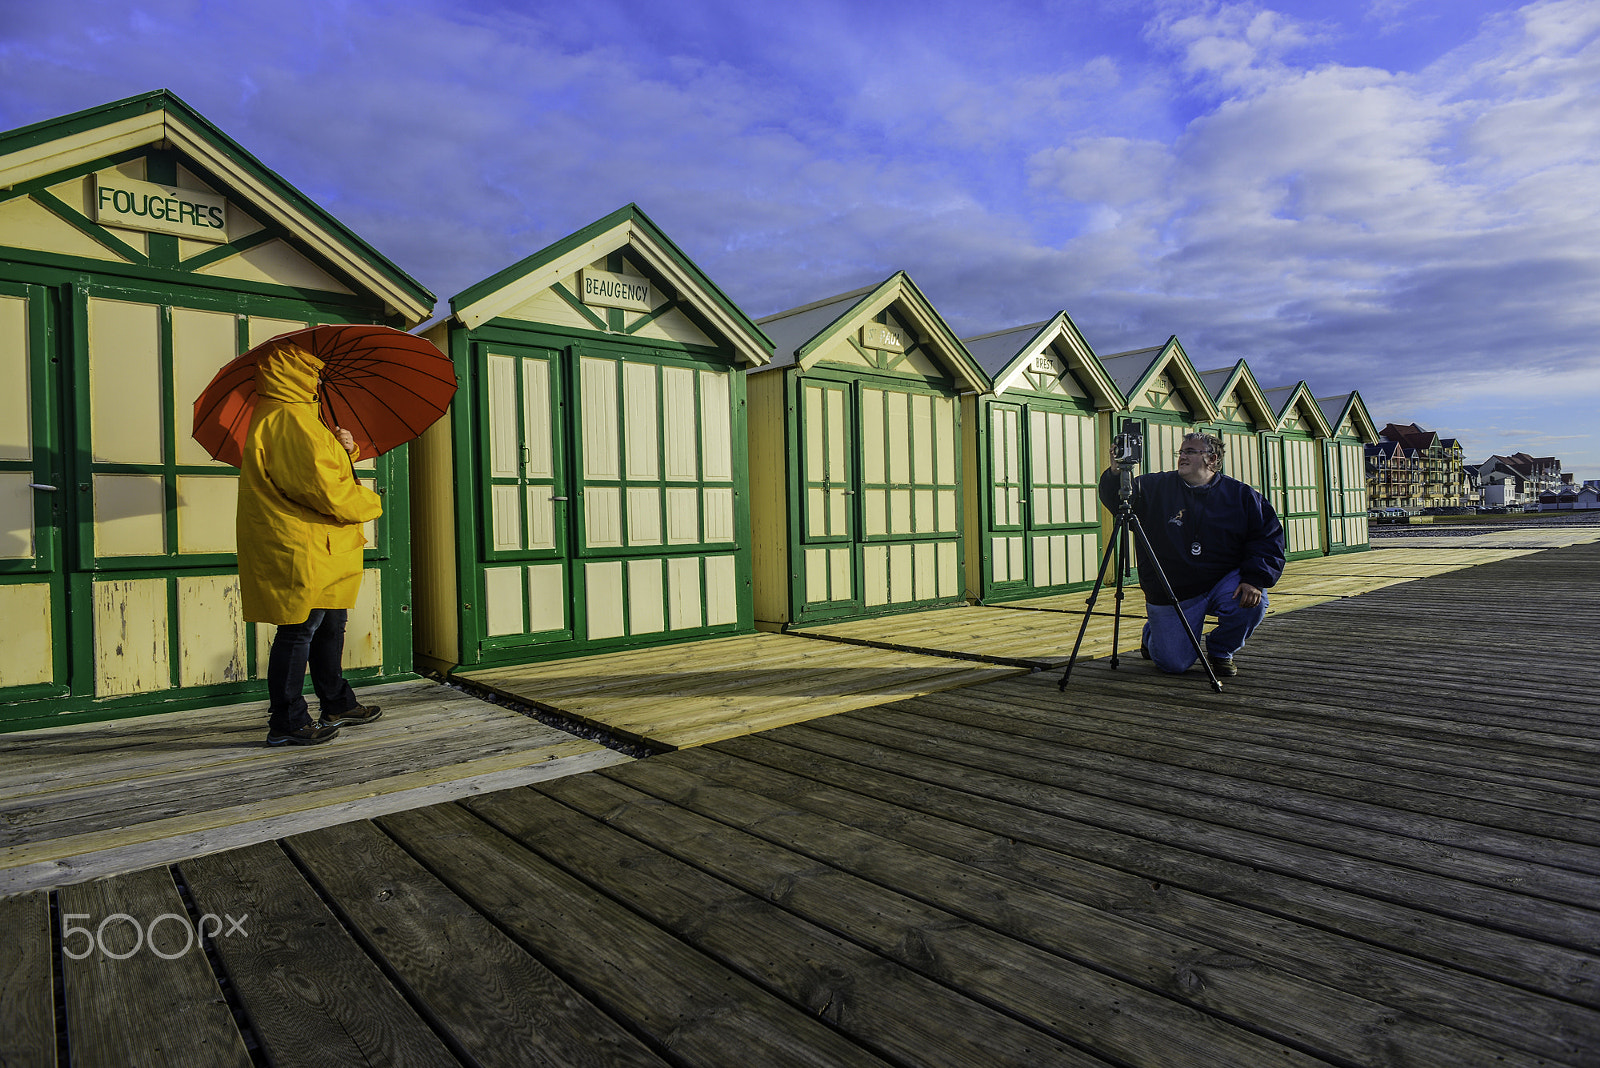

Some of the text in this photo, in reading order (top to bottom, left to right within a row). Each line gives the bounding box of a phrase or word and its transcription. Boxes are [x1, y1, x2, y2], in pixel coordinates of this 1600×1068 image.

[585, 277, 648, 303] BEAUGENCY
[880, 330, 901, 346] PAUL
[1035, 357, 1053, 370] BREST
